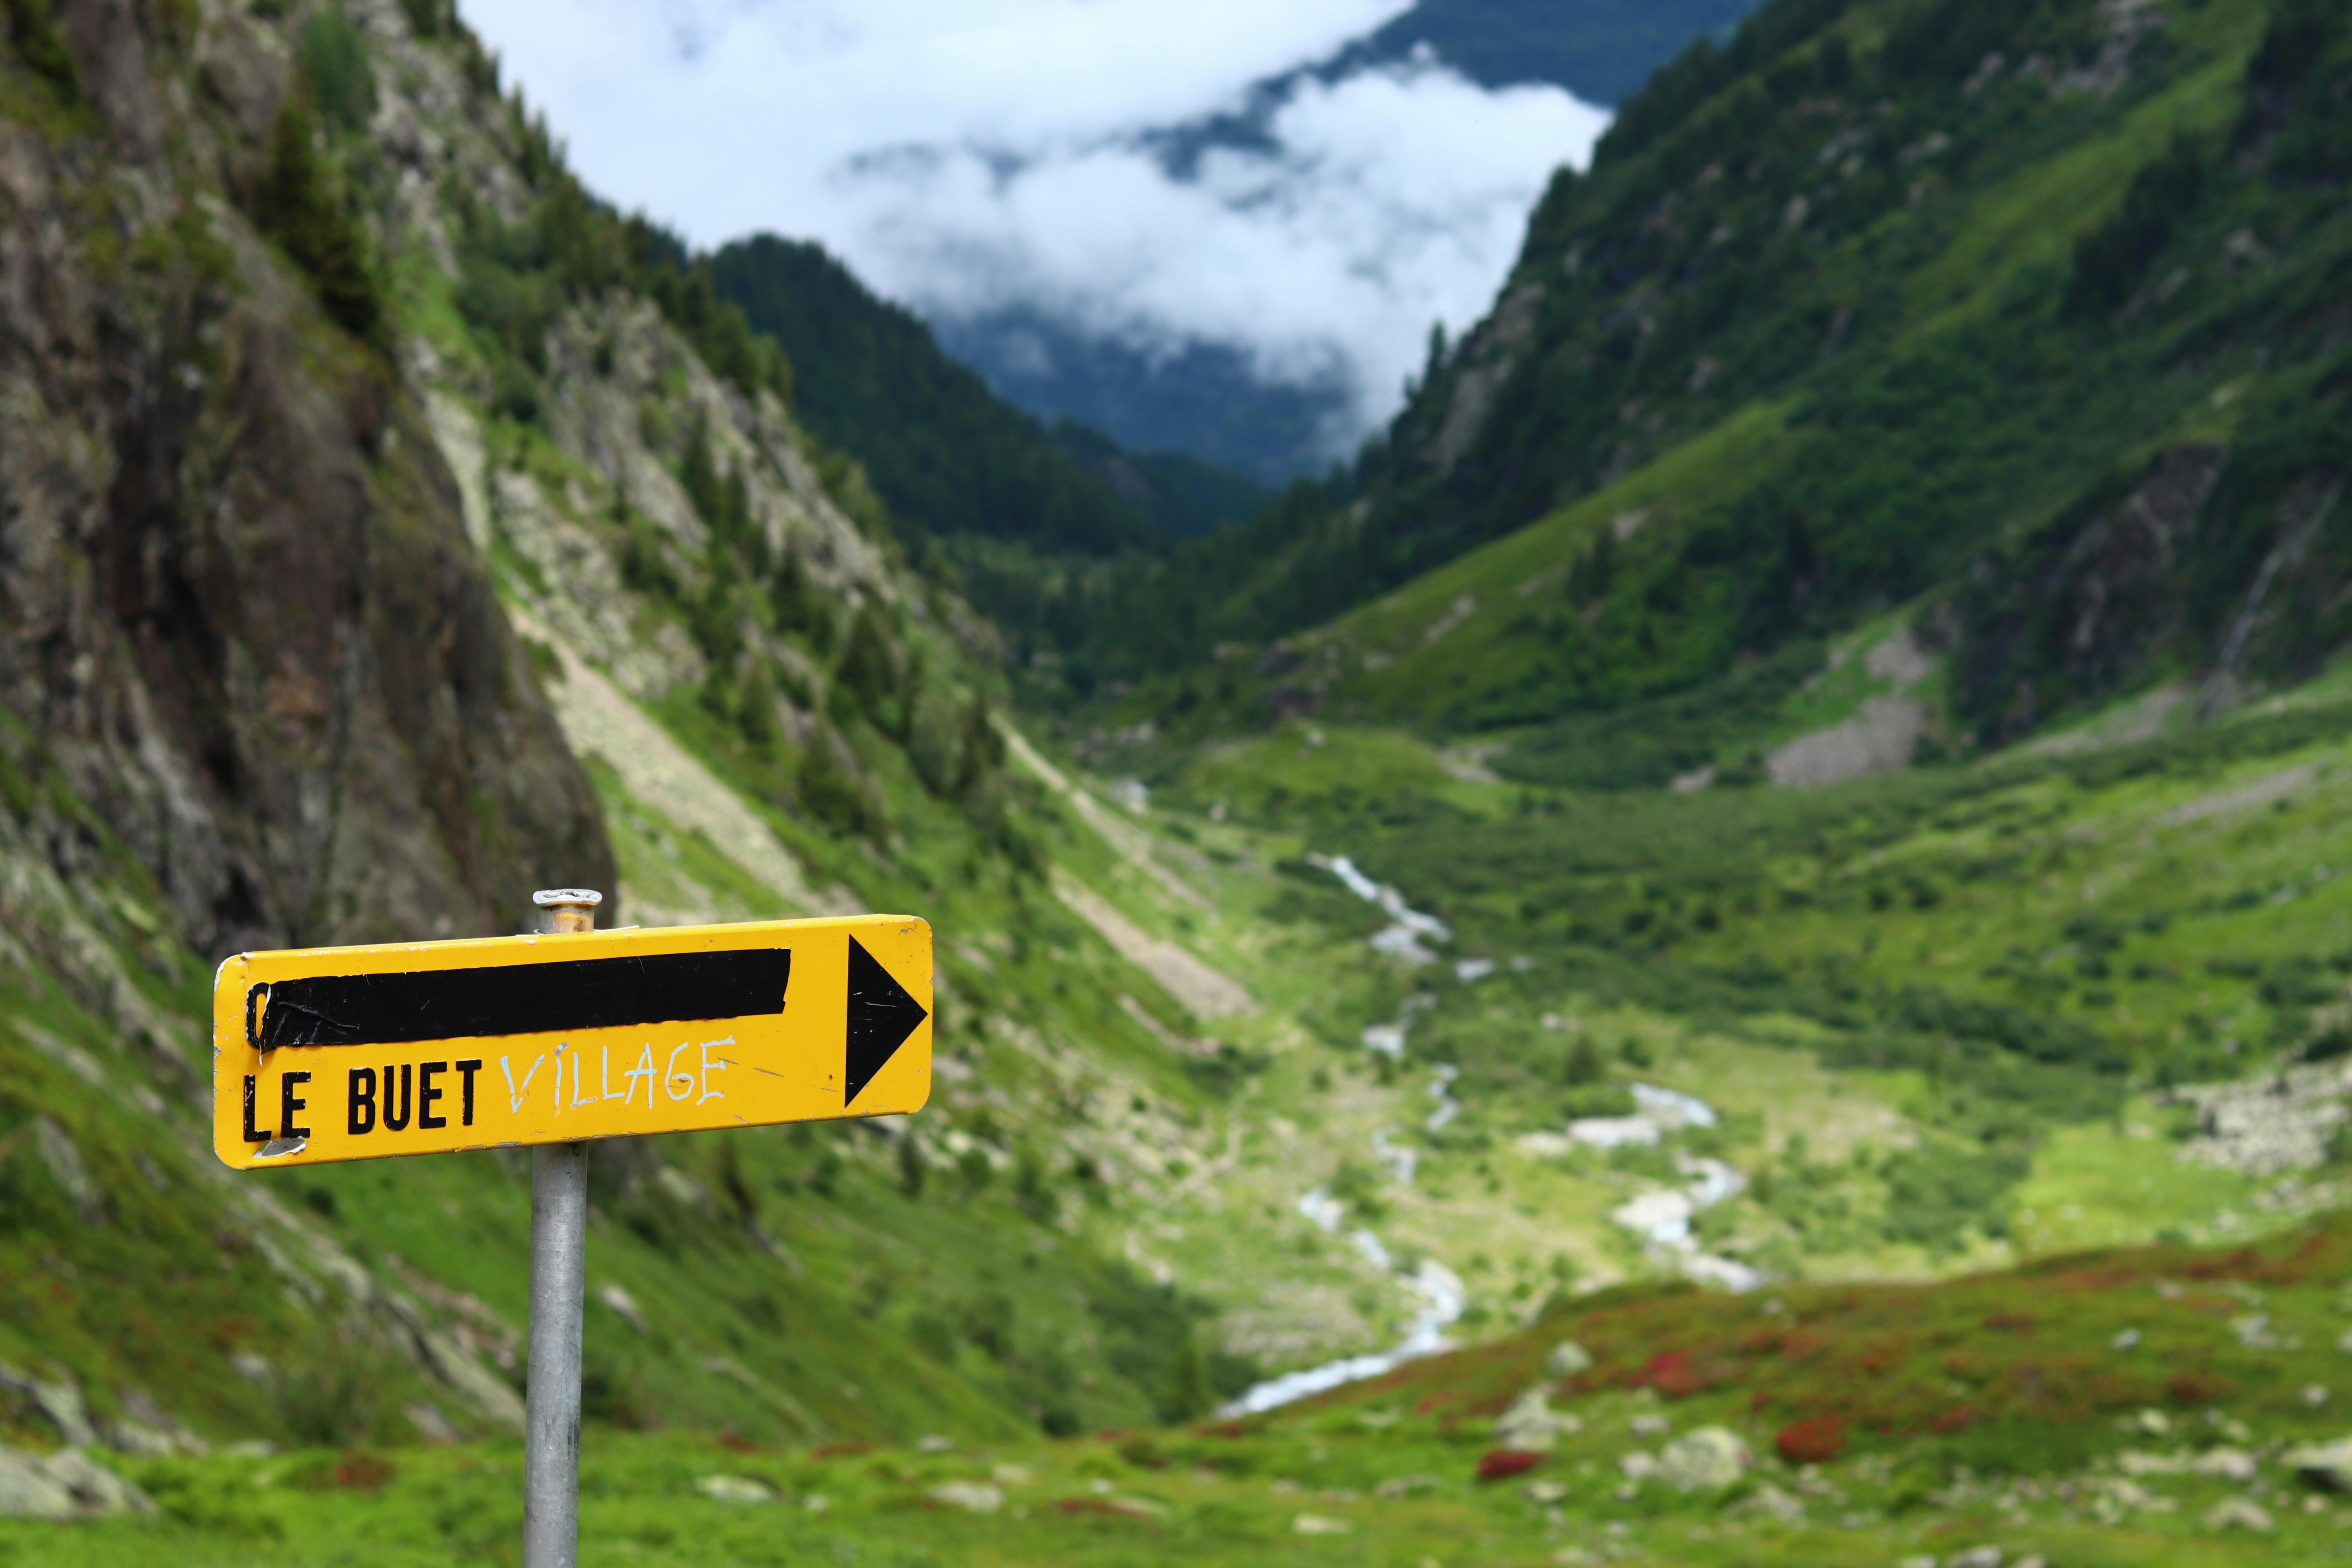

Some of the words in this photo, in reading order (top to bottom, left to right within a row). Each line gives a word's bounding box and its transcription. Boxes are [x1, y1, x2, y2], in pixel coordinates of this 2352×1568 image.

[243, 1071, 311, 1142] LE
[348, 1059, 482, 1135] BUET
[500, 1035, 735, 1114] VILLAGE
